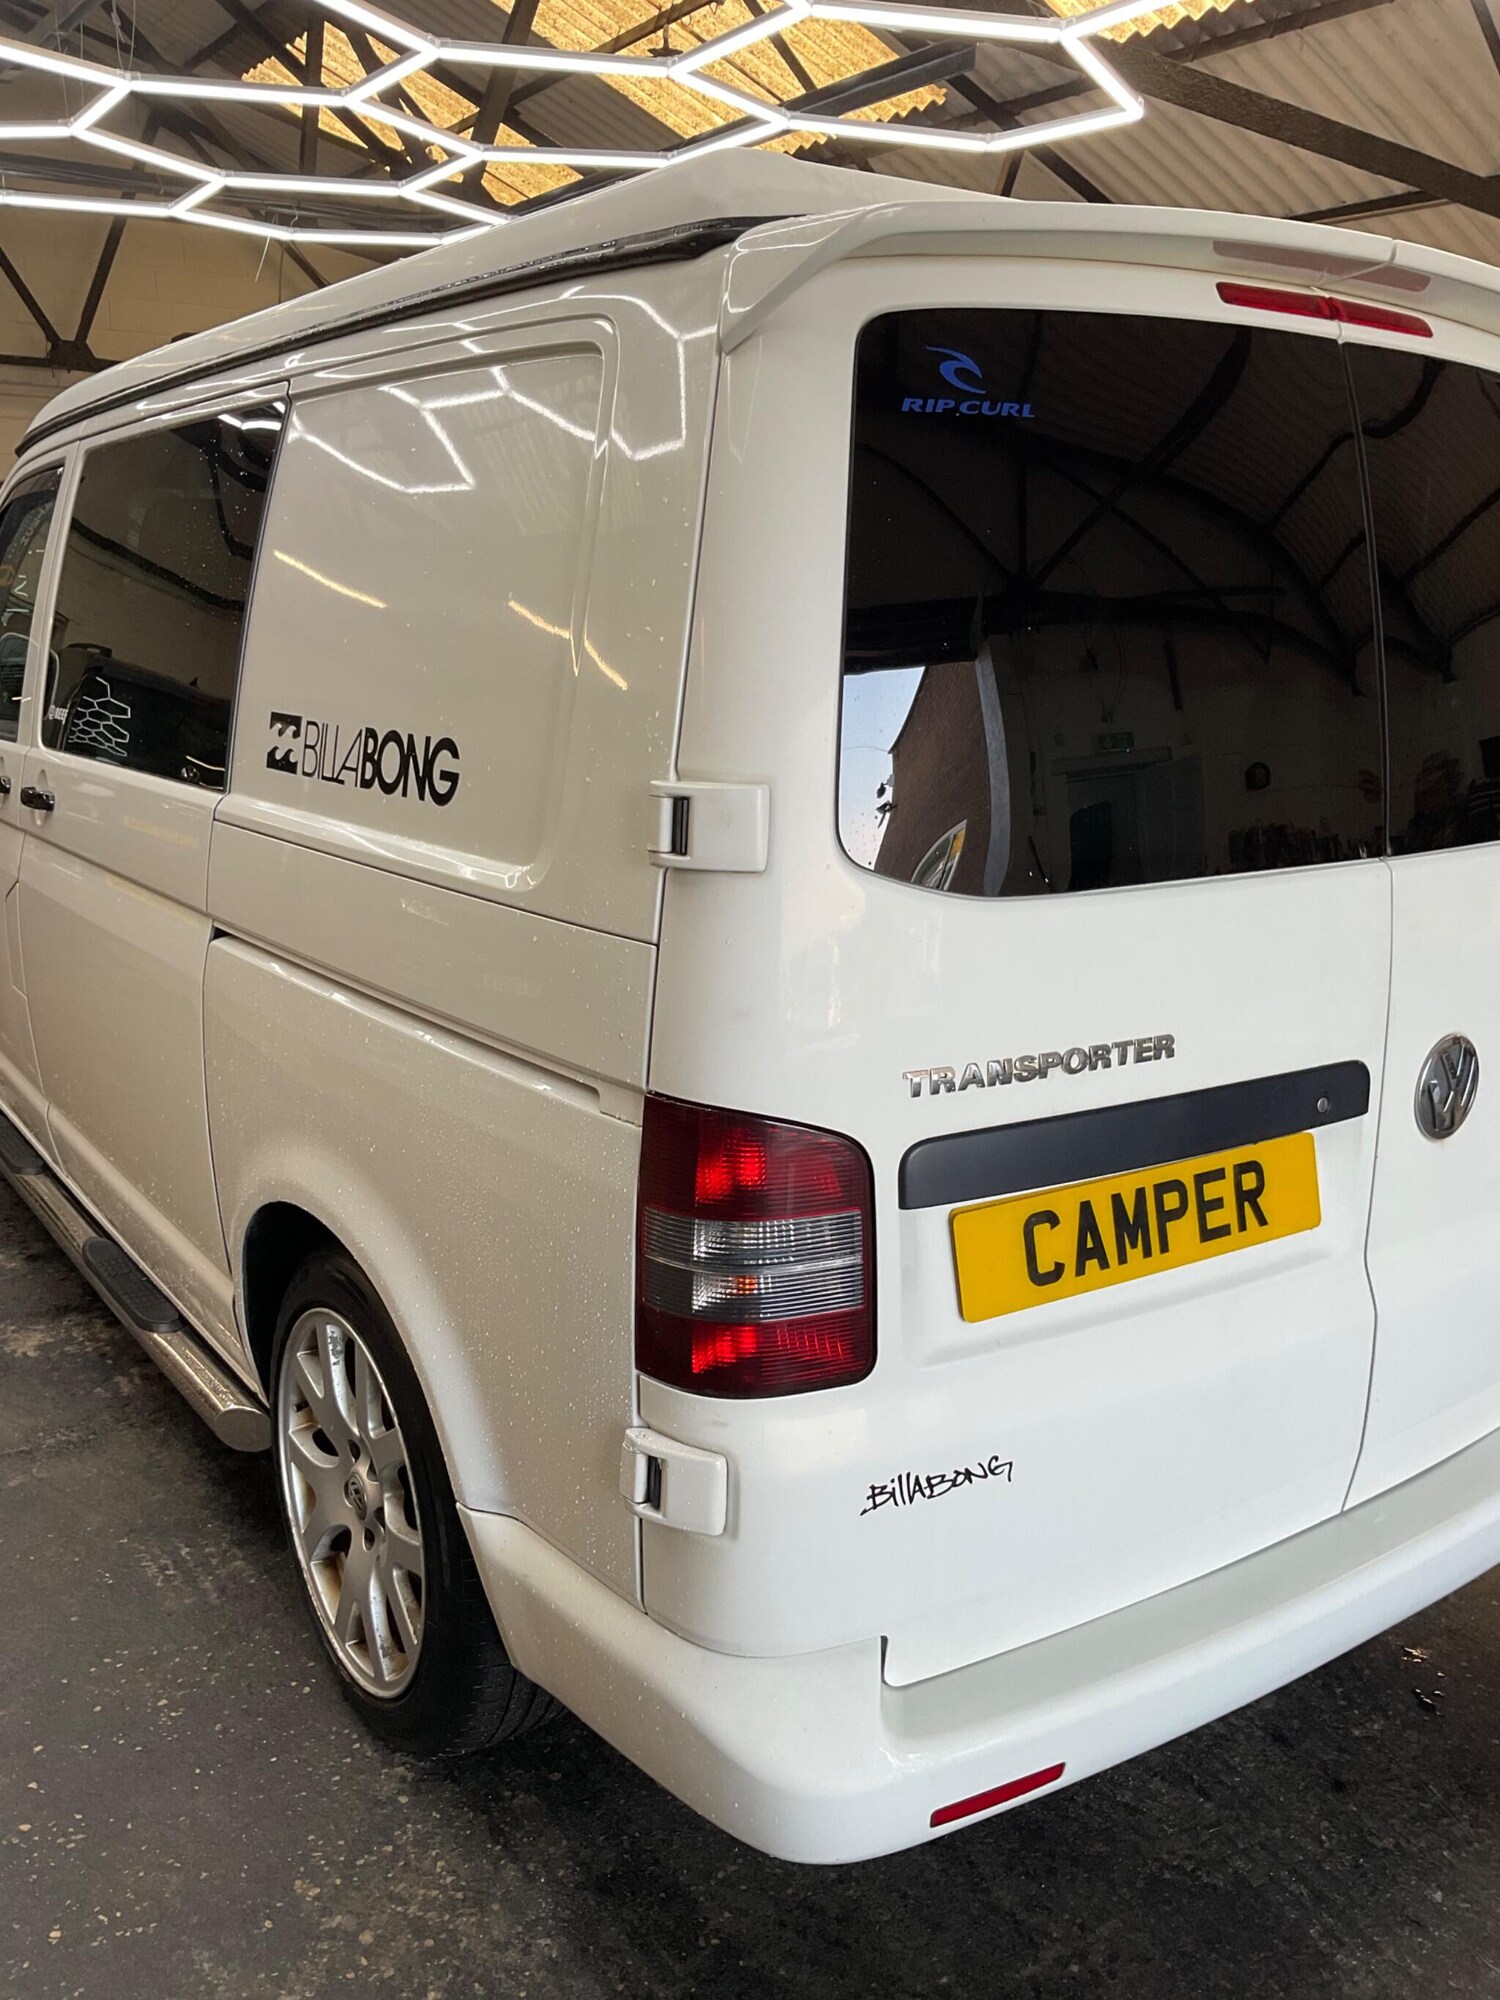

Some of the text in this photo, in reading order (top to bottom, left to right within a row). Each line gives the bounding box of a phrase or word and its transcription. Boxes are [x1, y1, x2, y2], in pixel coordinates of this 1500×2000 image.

[902, 398, 1035, 418] RIP CURL
[302, 720, 460, 807] BILLABONG
[902, 1034, 1175, 1098] TRANSPORTER
[1022, 1159, 1269, 1287] CAMPER
